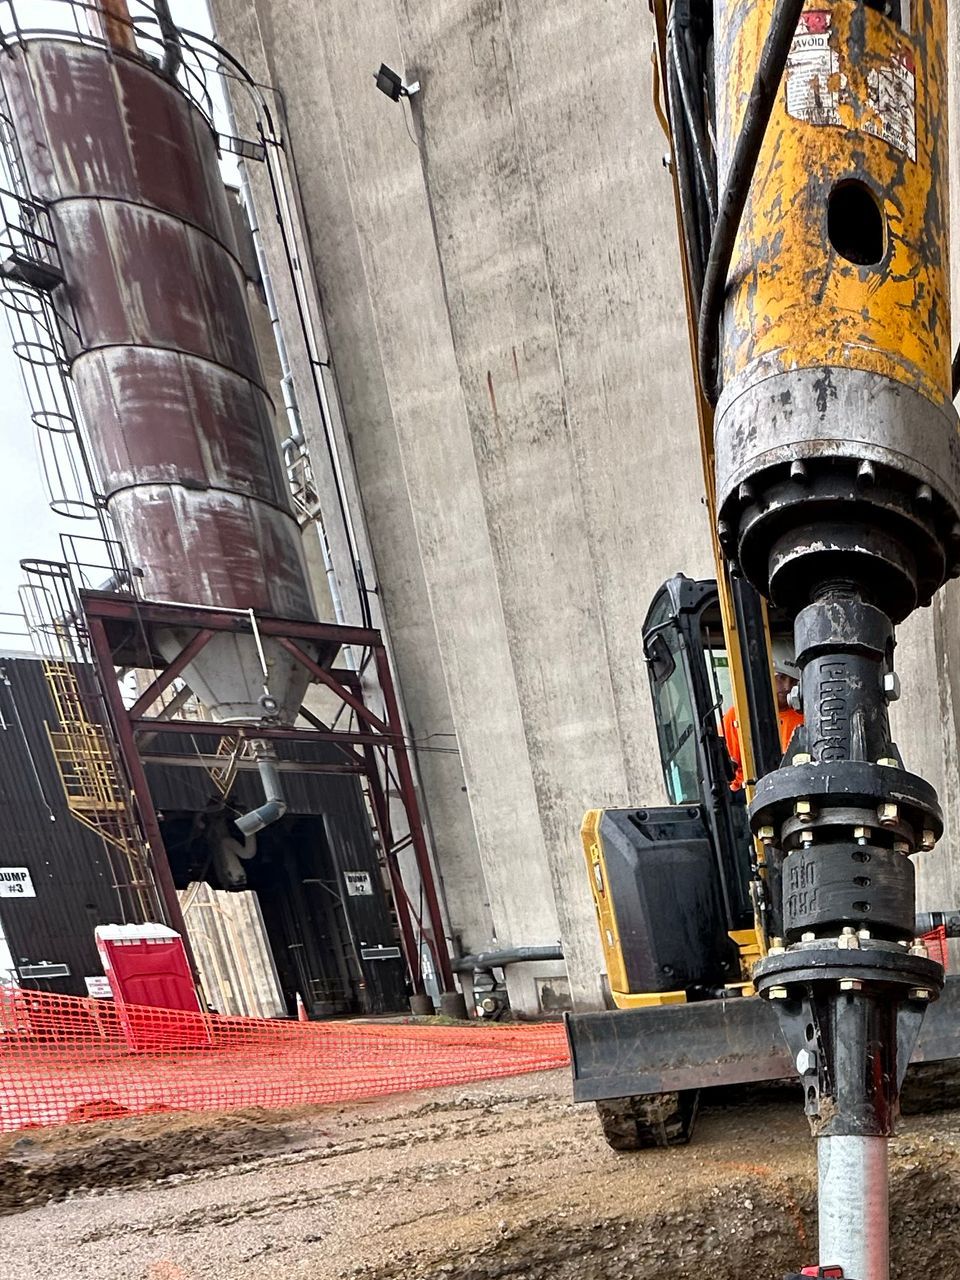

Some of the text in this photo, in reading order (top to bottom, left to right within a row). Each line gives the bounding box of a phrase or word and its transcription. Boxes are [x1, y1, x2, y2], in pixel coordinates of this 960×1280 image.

[796, 36, 825, 48] AVOID
[347, 875, 368, 883] DUMP
[8, 884, 24, 893] #3
